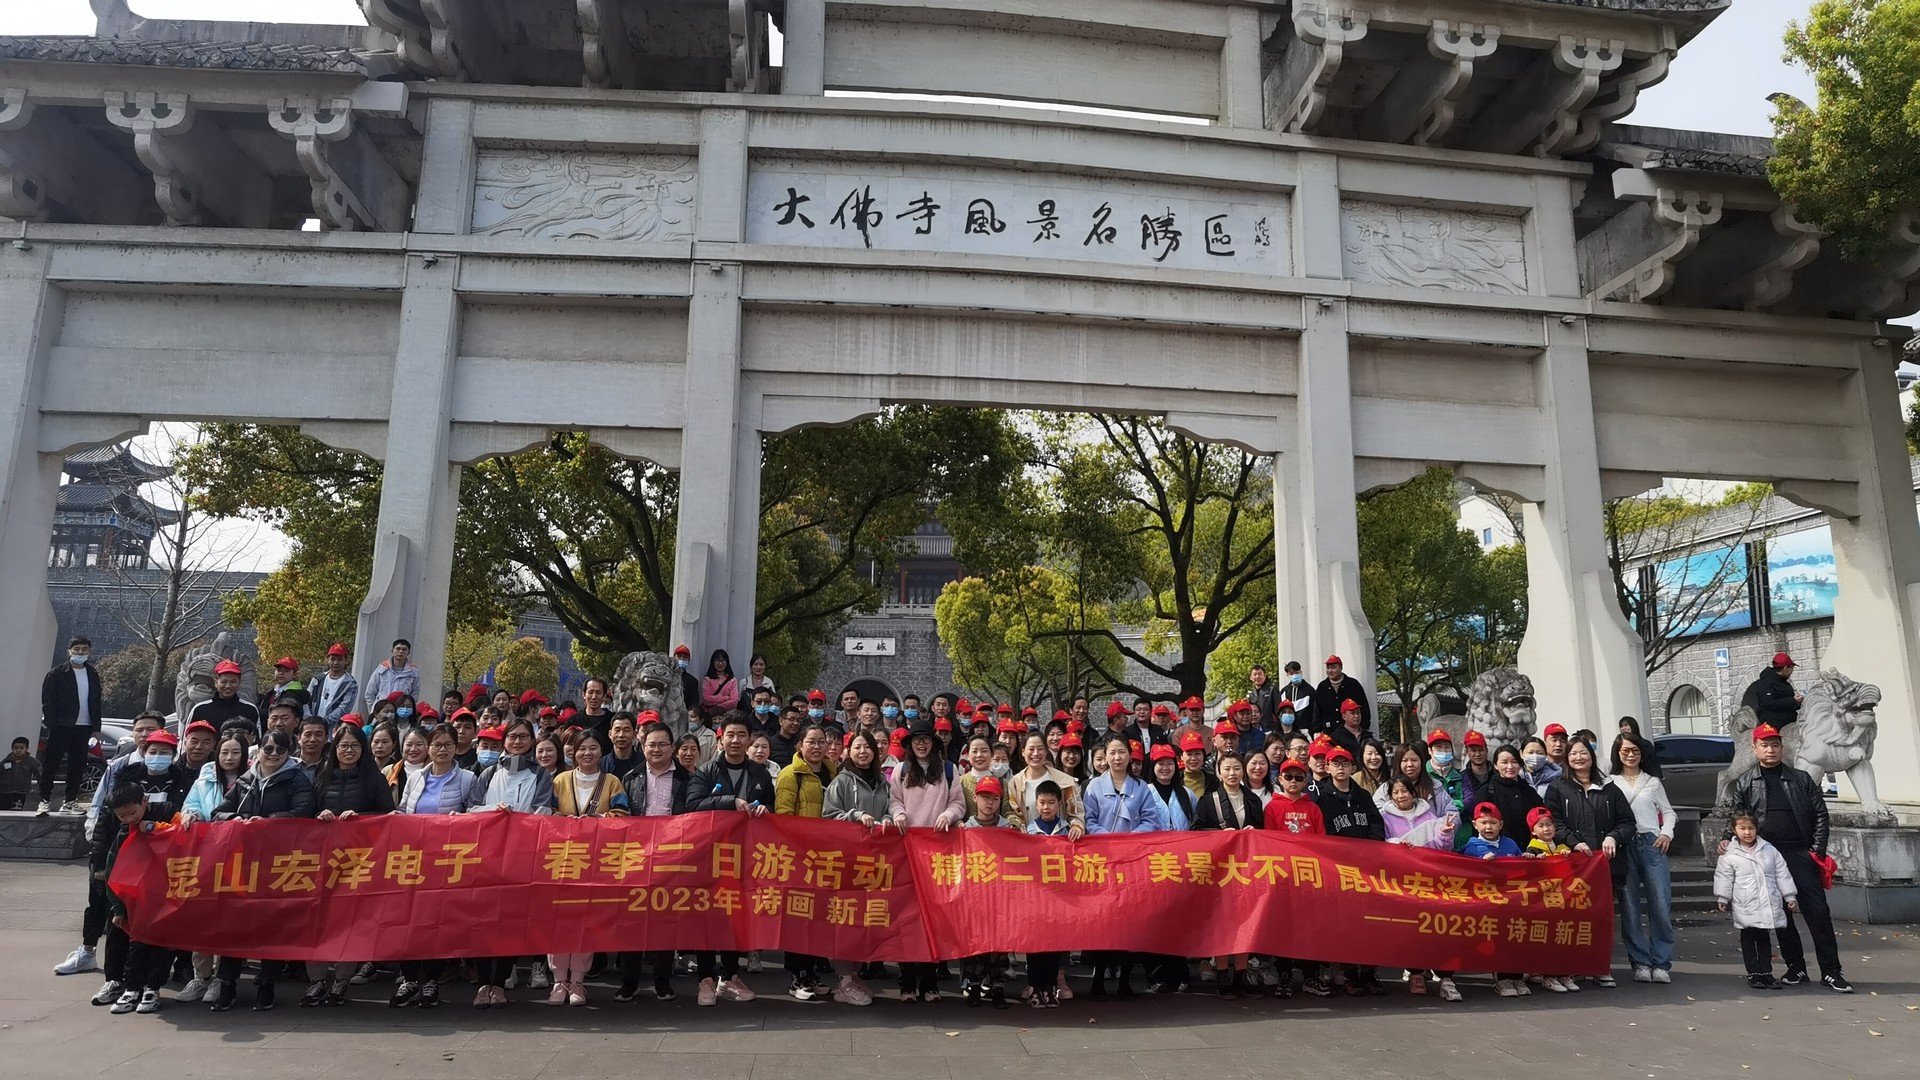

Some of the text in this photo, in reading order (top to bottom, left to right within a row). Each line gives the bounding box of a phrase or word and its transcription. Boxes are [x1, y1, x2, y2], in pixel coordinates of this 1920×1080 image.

[773, 184, 1235, 262] 大佛寺風景名勝區
[166, 840, 893, 899] 昆山宏泽电子 春季二日游活动
[1339, 864, 1593, 911] 昆山宏泽电子留念
[752, 887, 815, 920] 诗画
[825, 896, 891, 928] 新昌
[1507, 917, 1549, 944] 诗画
[1555, 919, 1593, 947] 新昌
